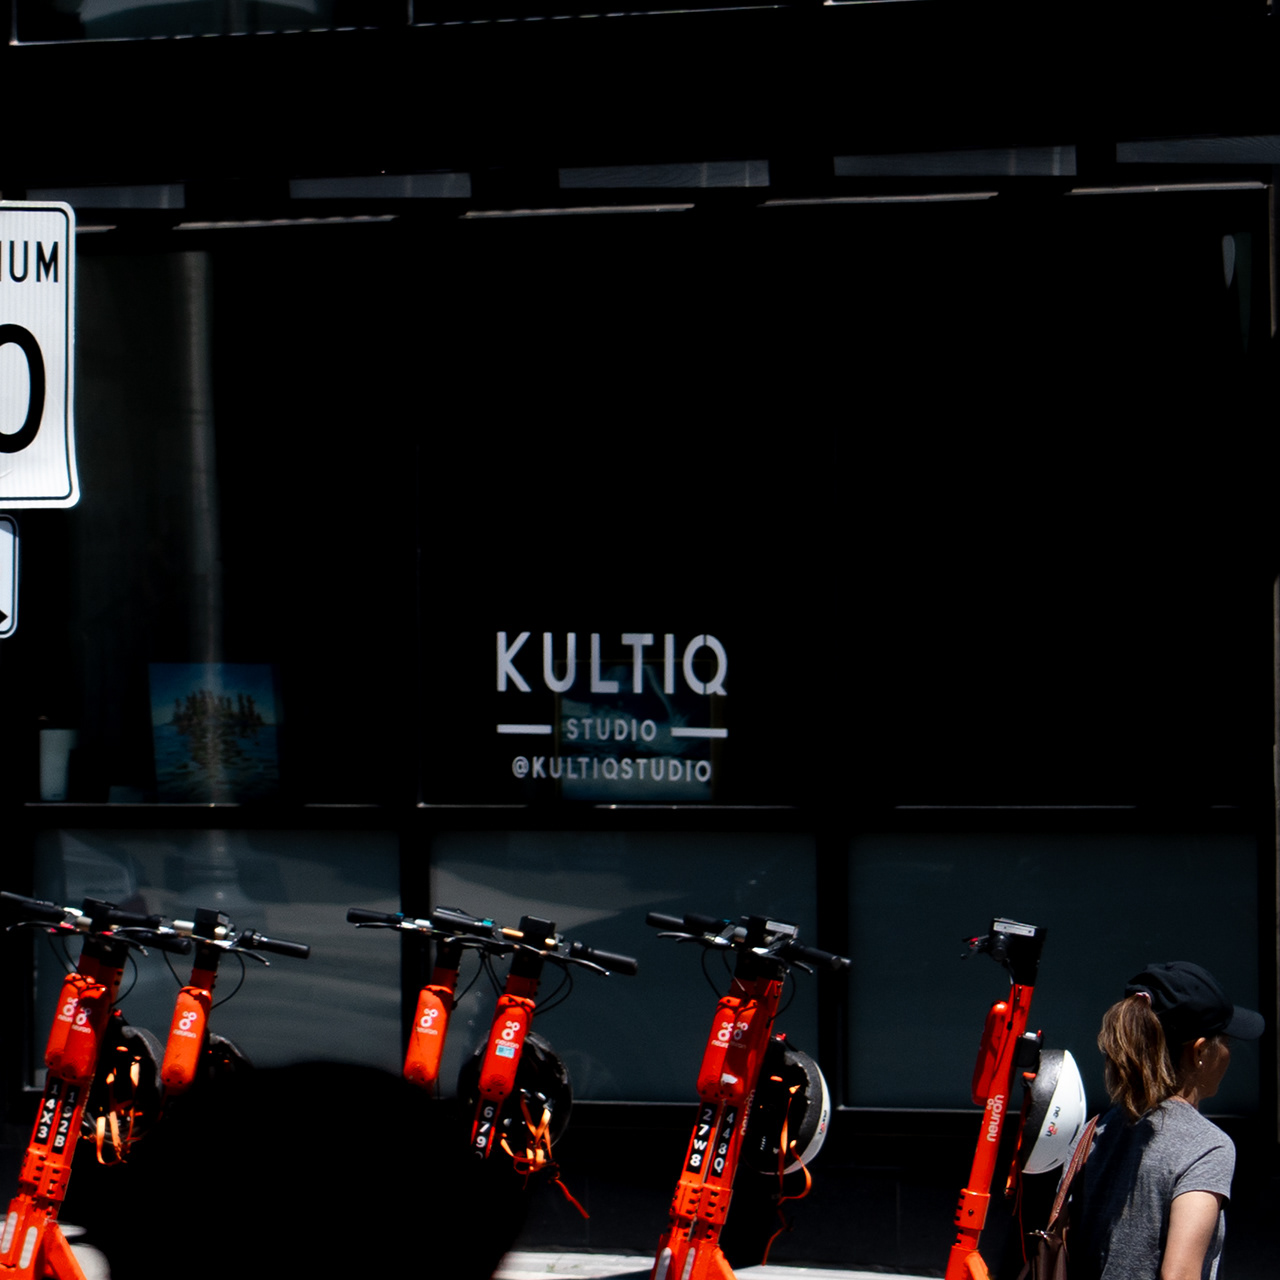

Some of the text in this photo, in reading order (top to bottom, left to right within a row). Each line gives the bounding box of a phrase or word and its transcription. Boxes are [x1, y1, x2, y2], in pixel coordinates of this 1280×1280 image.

[496, 631, 728, 696] KULTIQ
[566, 718, 657, 741] STUDIO
[512, 756, 712, 782] @KULTIQSTUDIO
[986, 1094, 1005, 1142] neuron
